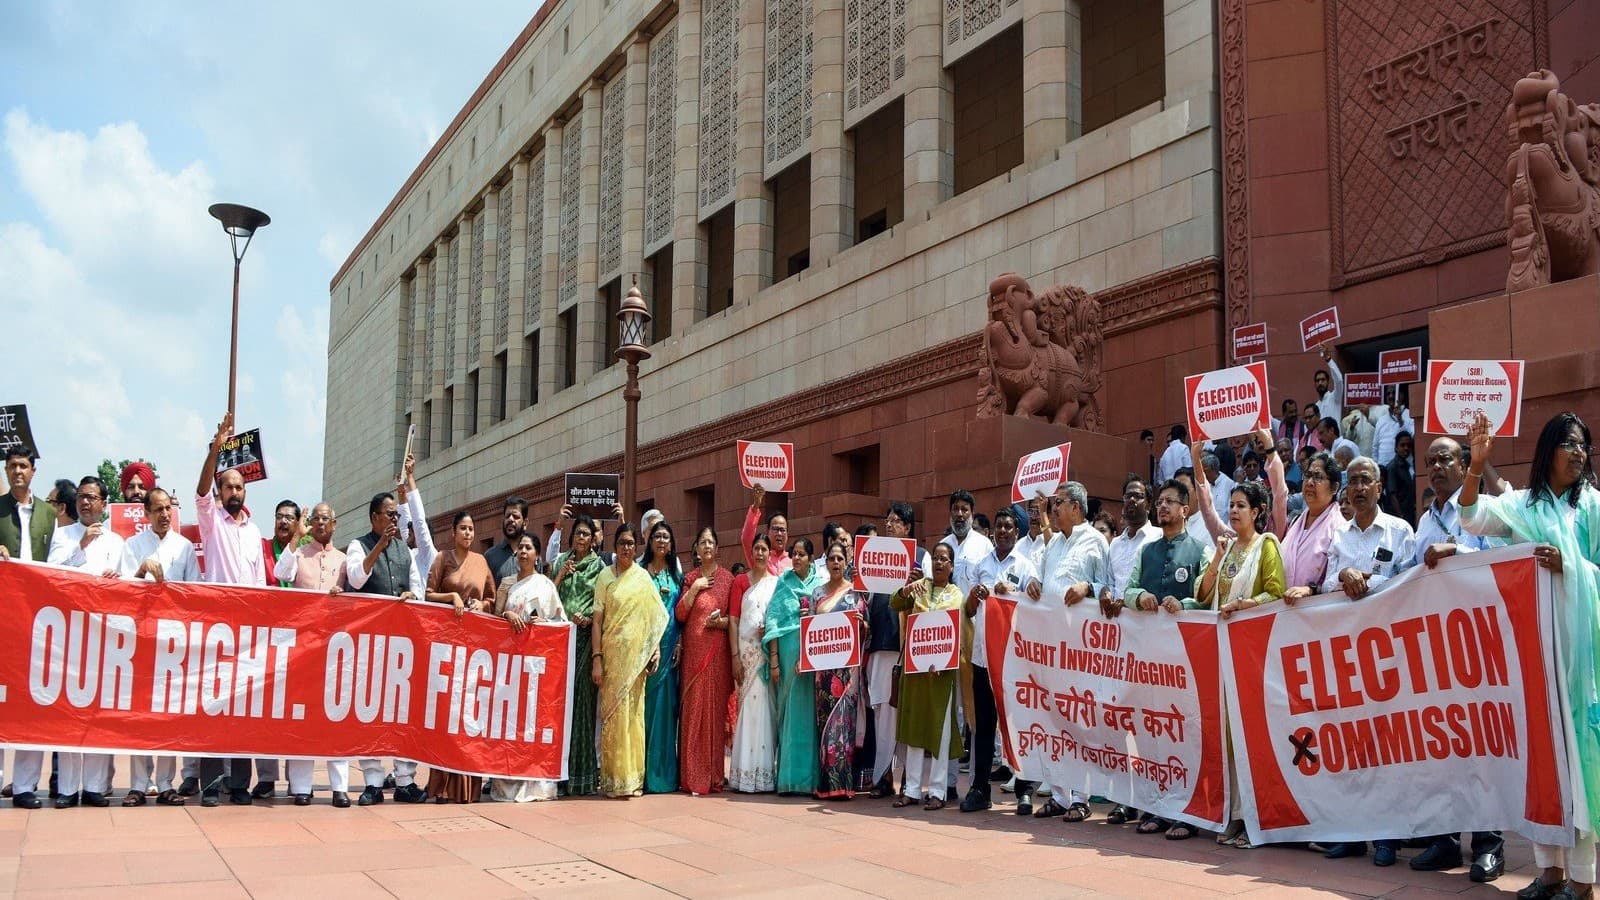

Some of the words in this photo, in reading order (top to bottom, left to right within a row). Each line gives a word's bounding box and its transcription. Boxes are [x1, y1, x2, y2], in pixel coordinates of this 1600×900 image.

[1363, 18, 1500, 102] सत्यमेव
[1385, 90, 1481, 159] जयते
[1197, 382, 1256, 408] ELECTION
[1443, 390, 1456, 401] वोट
[1459, 391, 1474, 402] चोरी
[1489, 391, 1503, 402] करो
[745, 455, 786, 469] ELECTION
[1022, 457, 1061, 476] ELECTION
[862, 551, 907, 567] ELECTION
[808, 626, 850, 644] ELECTION
[912, 625, 952, 643] ELECTION
[1081, 618, 1122, 653] (SIR)
[29, 606, 137, 710] OUR
[151, 618, 305, 720] RIGHT.
[324, 631, 414, 723] OUR
[424, 641, 553, 744] FIGHT.
[1013, 631, 1056, 667] SILENT
[1059, 641, 1124, 681] INVISIBLE
[1126, 651, 1187, 689] RIGGING
[1279, 605, 1509, 716] ELECTION
[1015, 673, 1050, 711] वोट
[1054, 686, 1097, 728] चोरी
[1102, 695, 1136, 736] बंद
[1142, 703, 1185, 743] करो
[1018, 723, 1048, 757] চুপি
[1051, 730, 1078, 761] চুপি
[1081, 744, 1129, 773] ভোটের
[1131, 754, 1188, 791] কারচুপি
